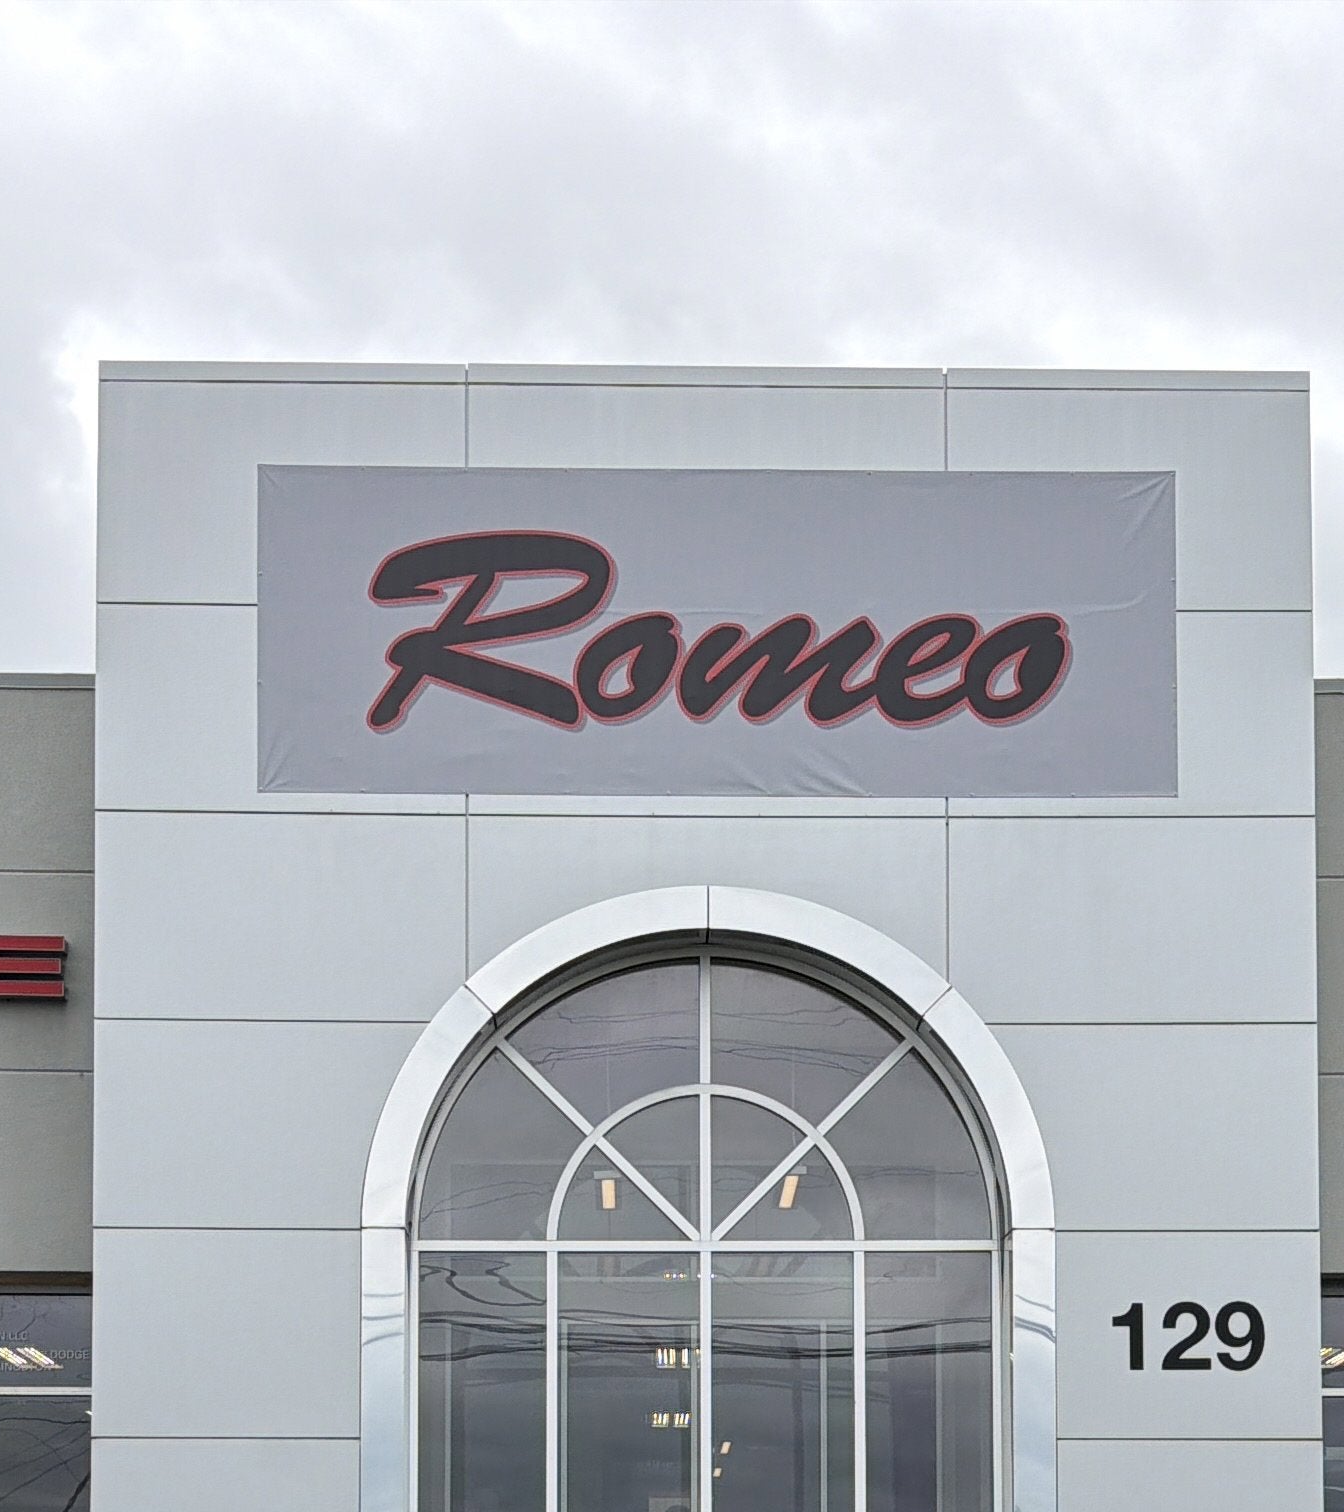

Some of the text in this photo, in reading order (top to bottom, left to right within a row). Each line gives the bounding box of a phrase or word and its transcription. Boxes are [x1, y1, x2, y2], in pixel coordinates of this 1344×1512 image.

[367, 529, 1072, 734] Romeo
[50, 1349, 90, 1360] DODGE
[1112, 1300, 1266, 1371] 129
